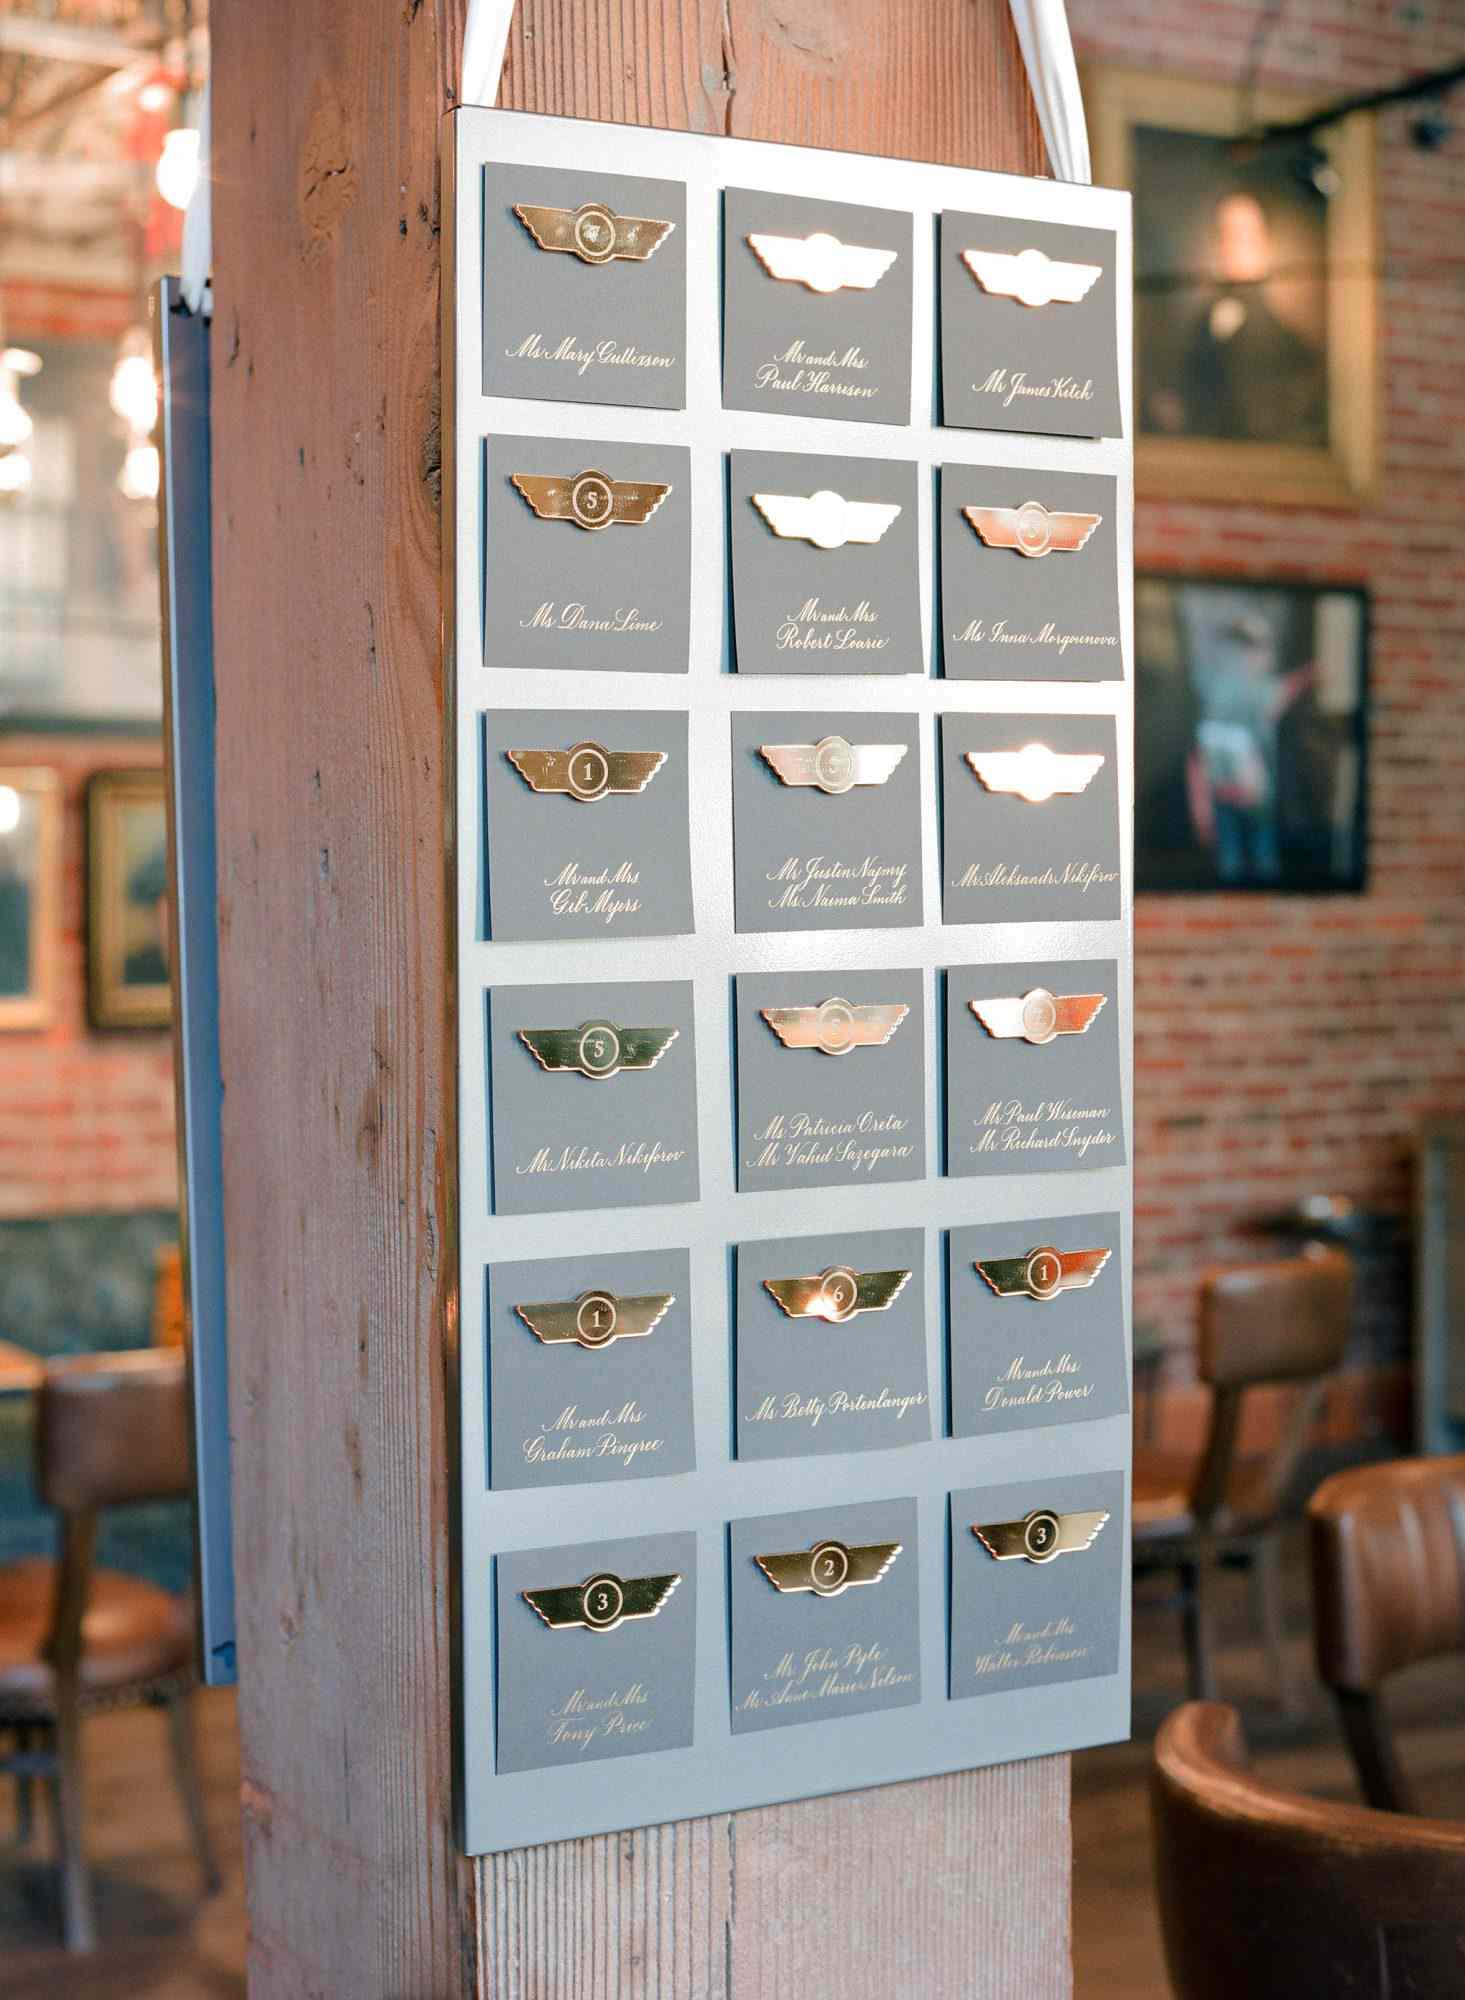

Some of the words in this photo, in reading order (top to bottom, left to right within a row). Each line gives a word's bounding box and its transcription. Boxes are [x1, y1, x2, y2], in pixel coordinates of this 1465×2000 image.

[545, 336, 595, 376] Mary
[773, 340, 805, 363] Mr
[806, 349, 836, 367] and
[833, 347, 869, 369] Mrs
[754, 363, 803, 390] Paul
[803, 370, 879, 398] Harrison
[972, 368, 1007, 393] Mr
[1003, 372, 1050, 407] James
[1050, 376, 1095, 400] Kitch
[586, 491, 598, 509] 5
[519, 601, 557, 628] Ms
[558, 602, 614, 630] Dana
[786, 597, 819, 622] Mr
[820, 607, 848, 622] and
[846, 600, 879, 623] Mrs
[776, 622, 833, 649] Robert
[583, 762, 593, 781] 1
[544, 861, 579, 887] Mr
[579, 868, 609, 885] and
[608, 861, 641, 884] Mrs
[799, 856, 850, 891] Justin
[585, 889, 642, 925] Myers
[861, 884, 908, 905] Smith
[789, 1112, 855, 1138] Patricia
[1000, 1099, 1045, 1125] Paul
[1000, 1125, 1062, 1152] Richard
[1060, 1125, 1118, 1158] Snyder
[1039, 1264, 1049, 1281] 1
[833, 1285, 845, 1302] 6
[591, 1309, 601, 1328] 1
[1024, 1359, 1055, 1379] and
[1053, 1353, 1082, 1375] Mrs
[781, 1391, 827, 1427] Betty
[980, 1385, 1045, 1411] Donald
[541, 1404, 578, 1431] Mr
[578, 1408, 610, 1429] and
[607, 1400, 648, 1426] Mrs
[522, 1435, 596, 1464] Graham
[1036, 1526, 1047, 1544] 3
[823, 1559, 835, 1577] 2
[597, 1592, 609, 1611] 3
